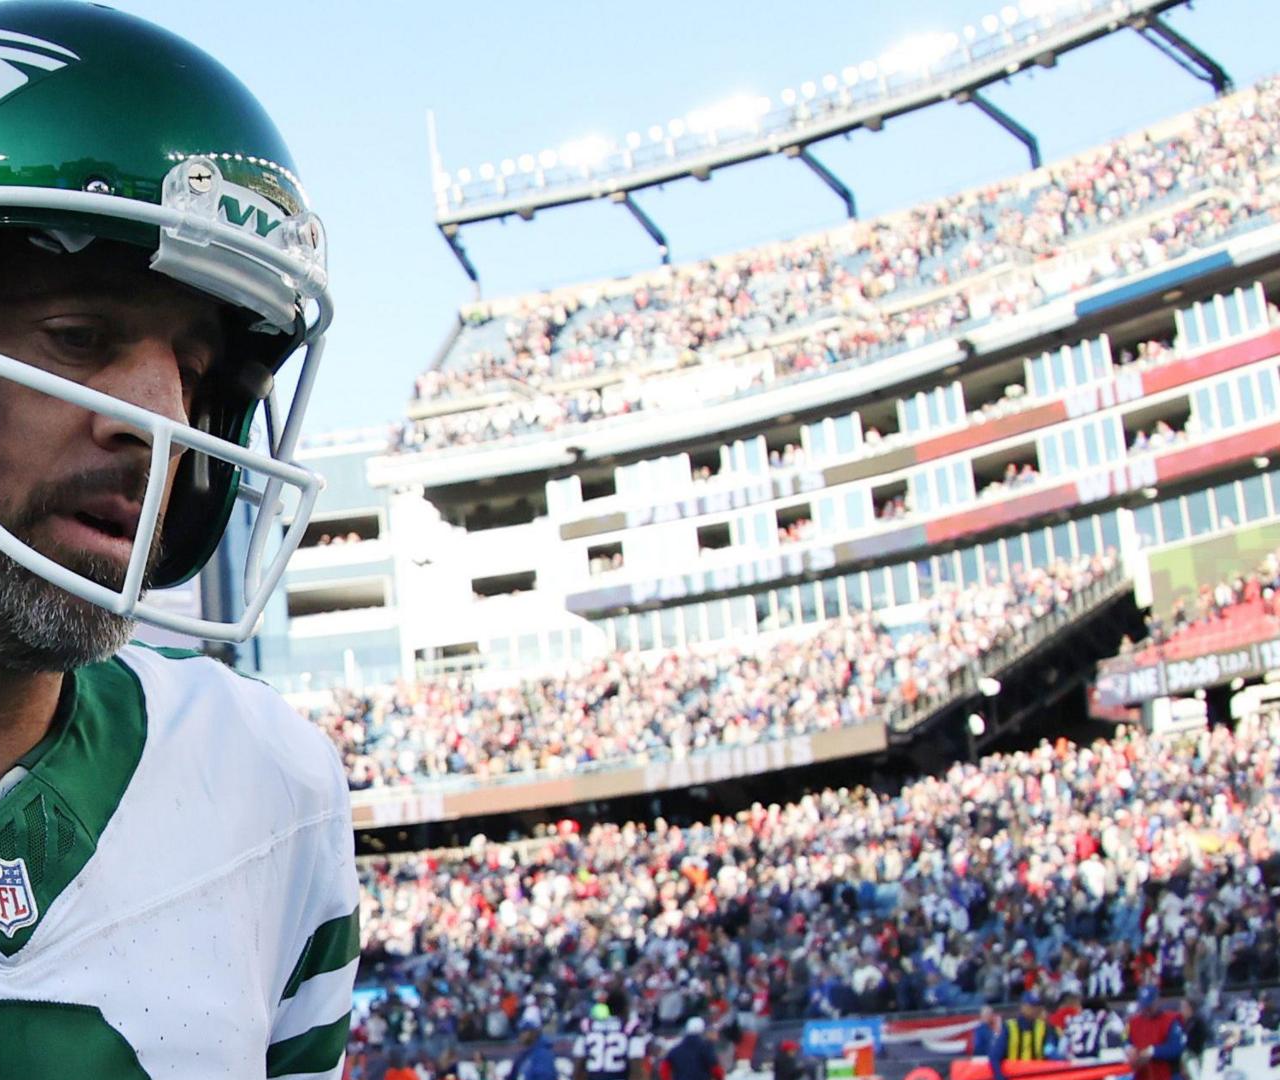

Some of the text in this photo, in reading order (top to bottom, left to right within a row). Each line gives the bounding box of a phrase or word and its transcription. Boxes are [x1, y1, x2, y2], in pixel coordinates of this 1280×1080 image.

[219, 194, 282, 238] NY
[1065, 372, 1144, 418] WIN
[1076, 458, 1158, 504] WIN
[1129, 668, 1158, 696] NE
[1167, 654, 1220, 689] 30:26
[585, 1031, 628, 1073] 32
[1067, 1023, 1098, 1053] 27
